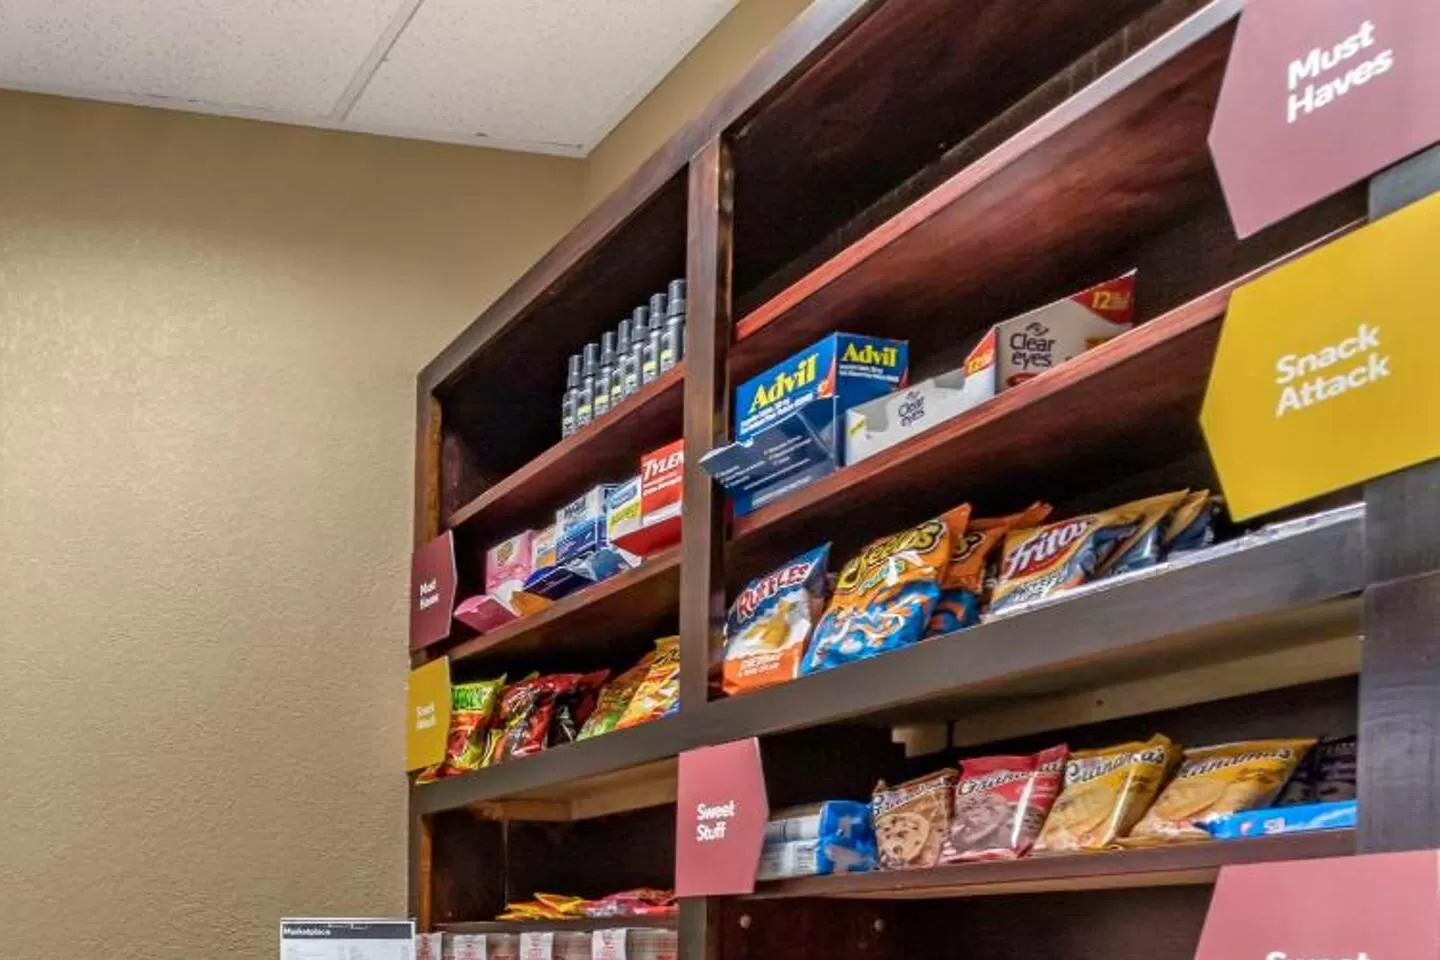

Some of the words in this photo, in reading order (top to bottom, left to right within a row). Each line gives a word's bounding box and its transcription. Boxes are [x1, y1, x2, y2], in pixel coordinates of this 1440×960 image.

[1287, 20, 1376, 91] Must
[1286, 49, 1394, 124] Haves
[1009, 332, 1056, 351] Clear
[842, 343, 898, 367] Advil
[1010, 350, 1053, 370] eyes
[1274, 323, 1381, 385] Snack
[748, 353, 820, 414] Advil
[1274, 351, 1391, 419] Attack
[897, 396, 925, 418] Clear
[695, 799, 735, 821] Sweet
[695, 821, 727, 842] Stuff
